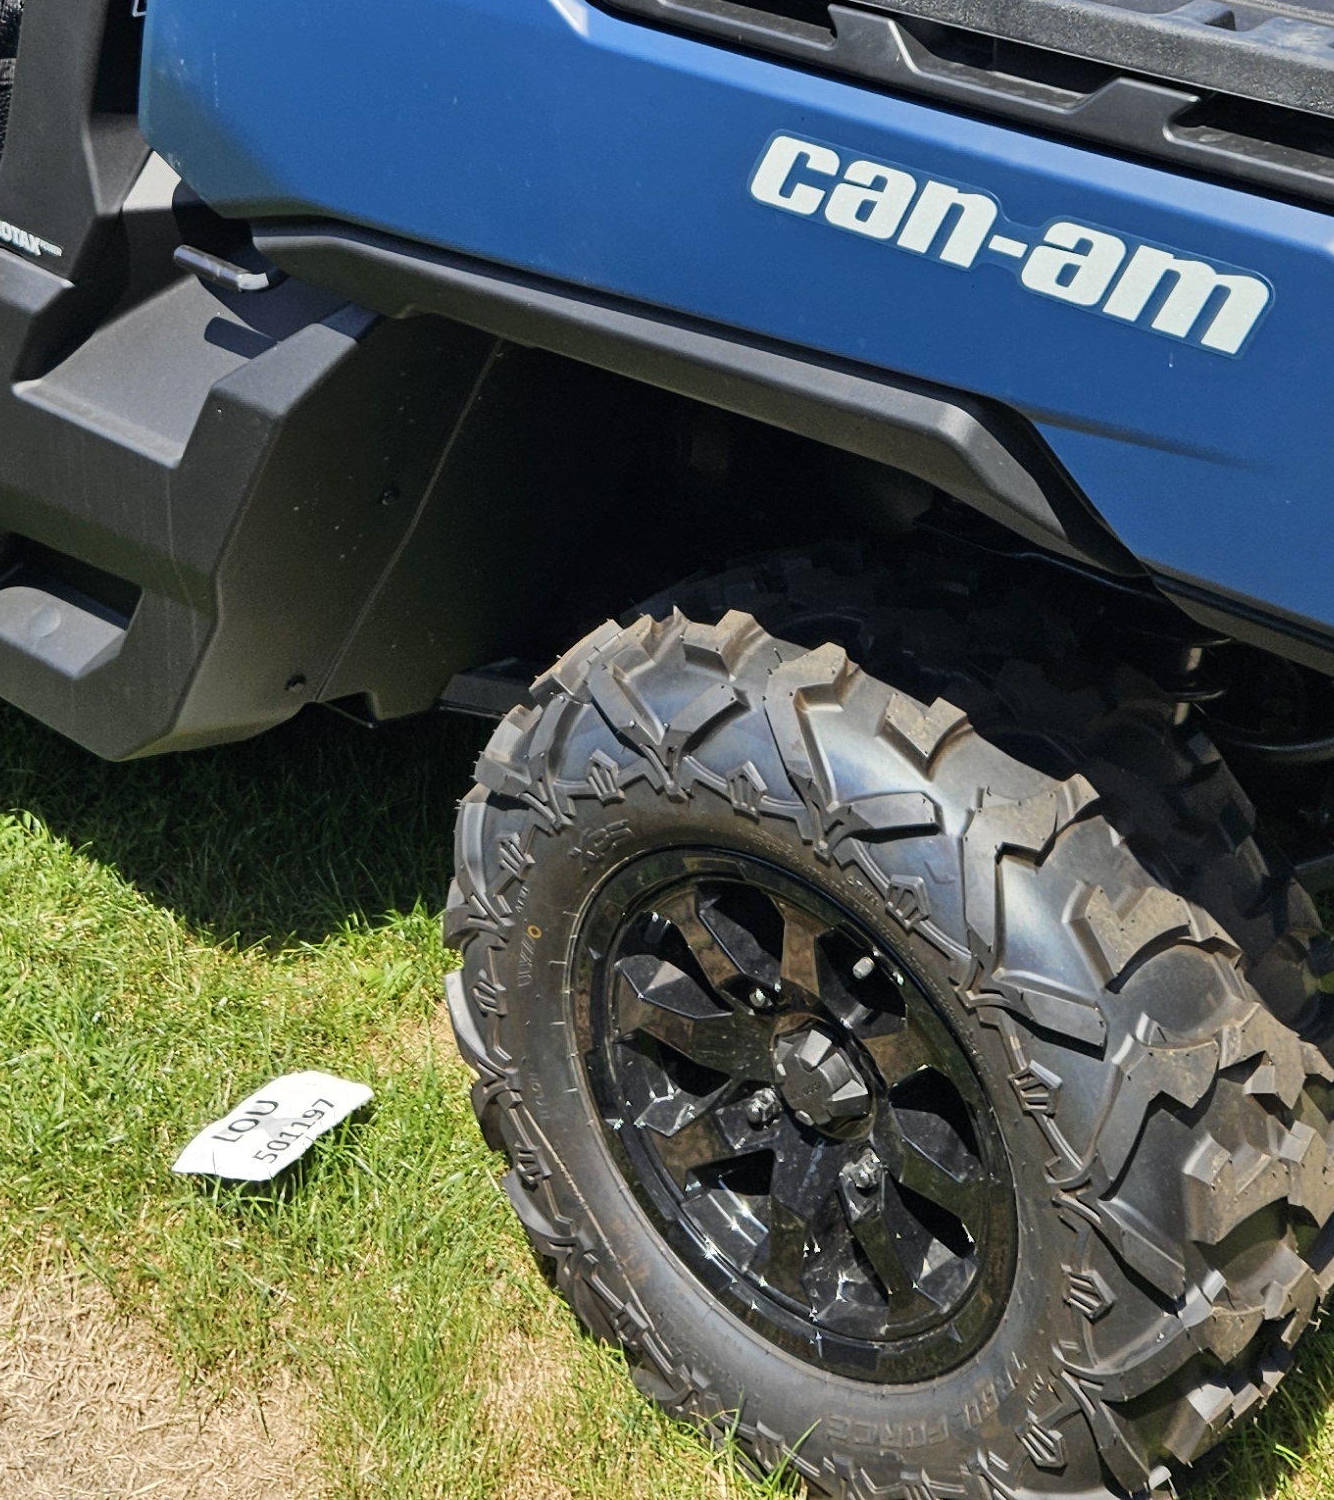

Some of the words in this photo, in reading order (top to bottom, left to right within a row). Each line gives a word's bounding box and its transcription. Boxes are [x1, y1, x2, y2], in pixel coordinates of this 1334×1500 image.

[750, 135, 1271, 354] can-am
[211, 1099, 280, 1143] LOU
[253, 1098, 335, 1164] 501197
